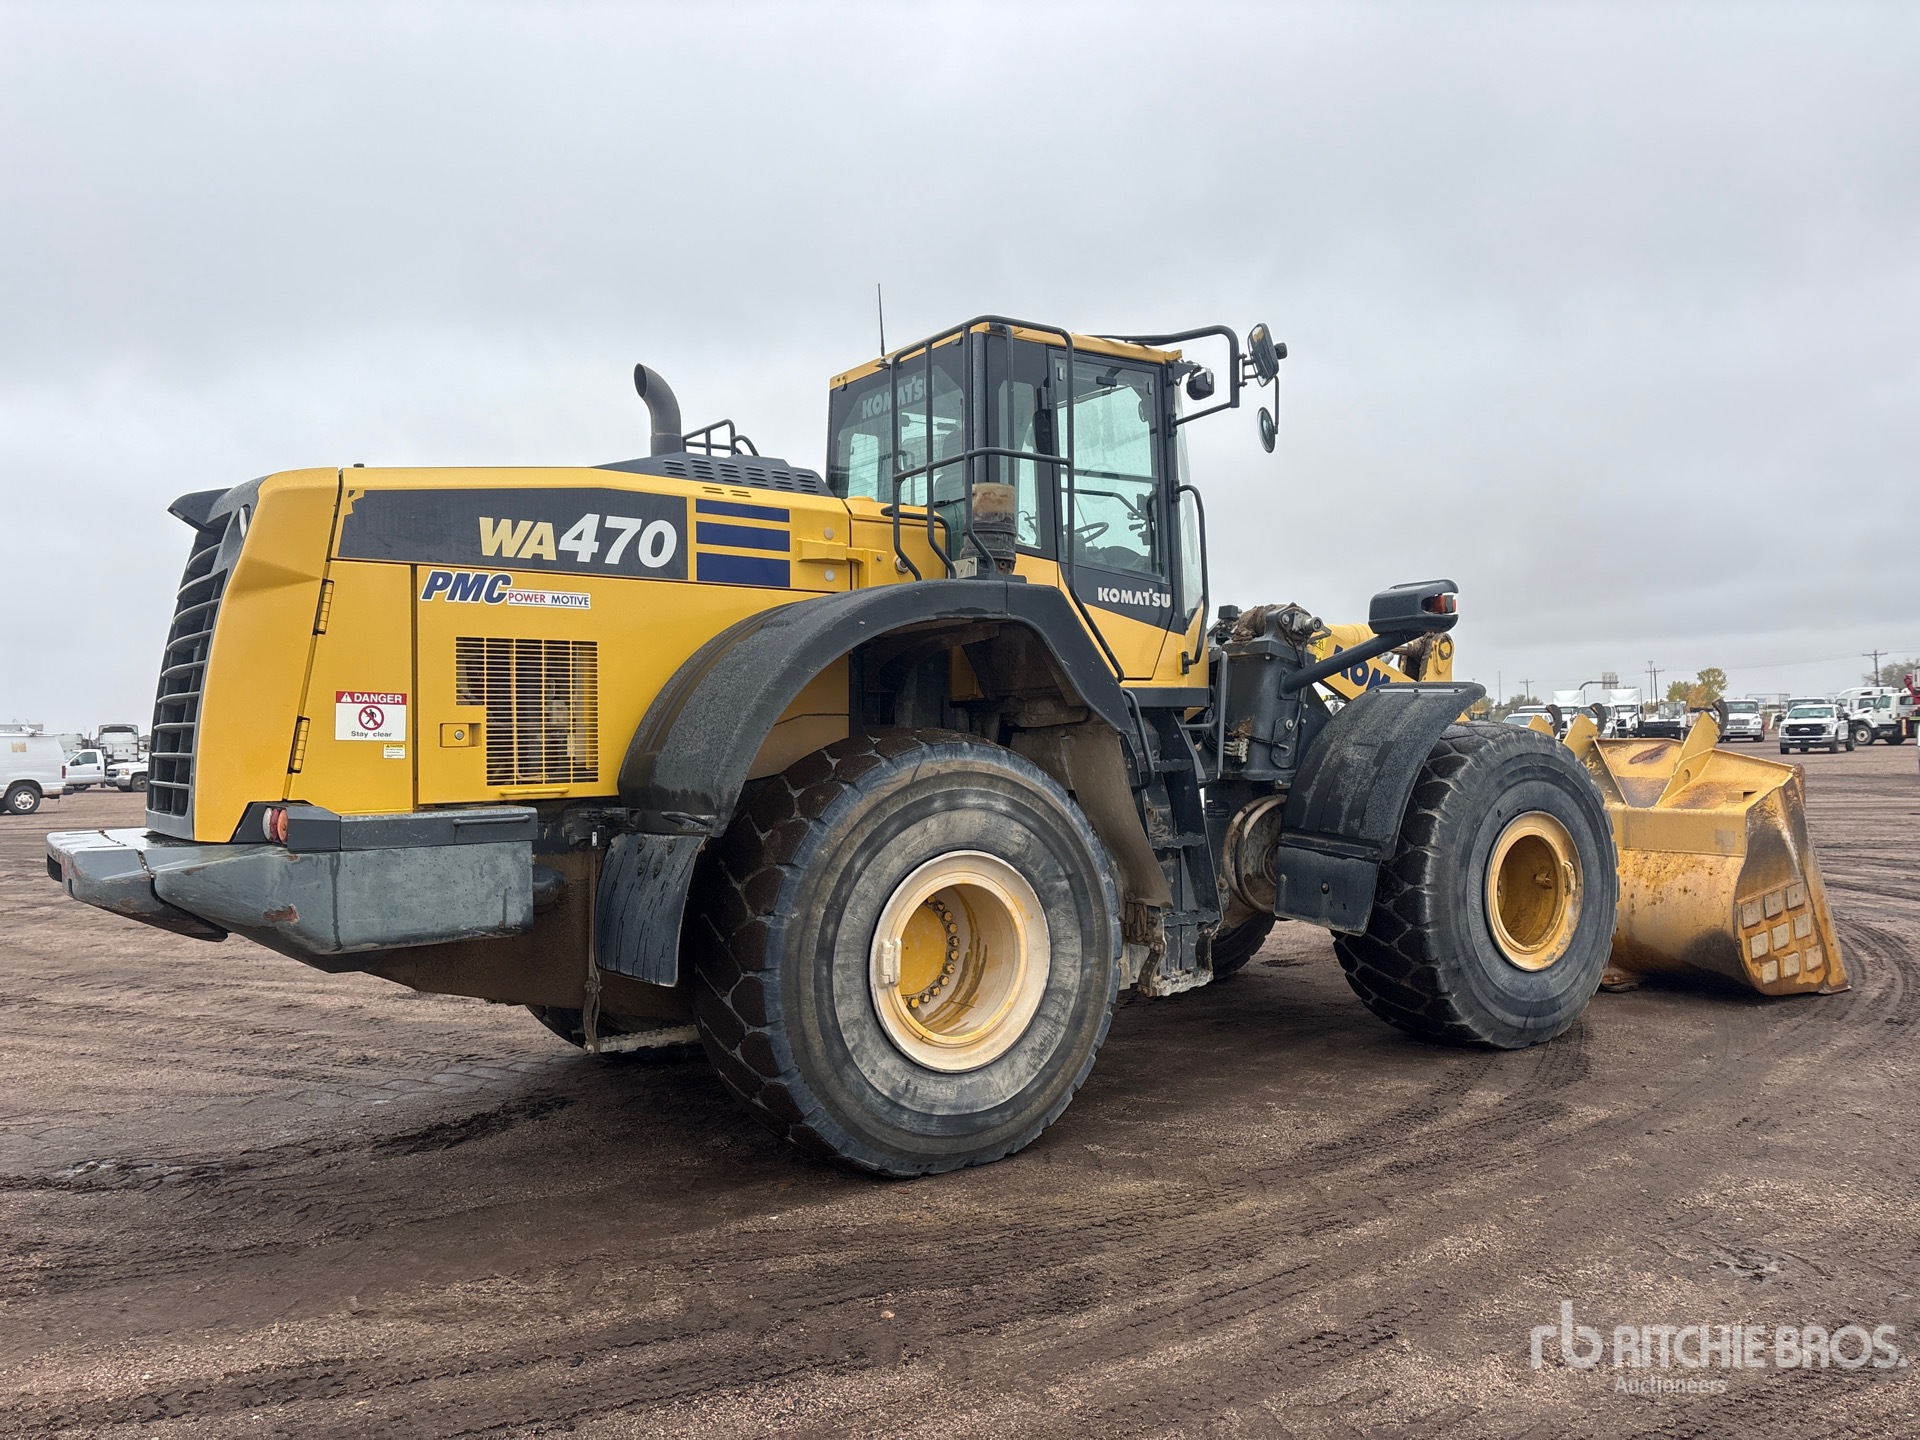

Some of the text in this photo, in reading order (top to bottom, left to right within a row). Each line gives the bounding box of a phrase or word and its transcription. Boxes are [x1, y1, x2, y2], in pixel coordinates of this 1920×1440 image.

[421, 571, 589, 606] PMC POWER MOTIVE
[1097, 587, 1171, 608] KOMATSU
[354, 693, 402, 703] DANGER
